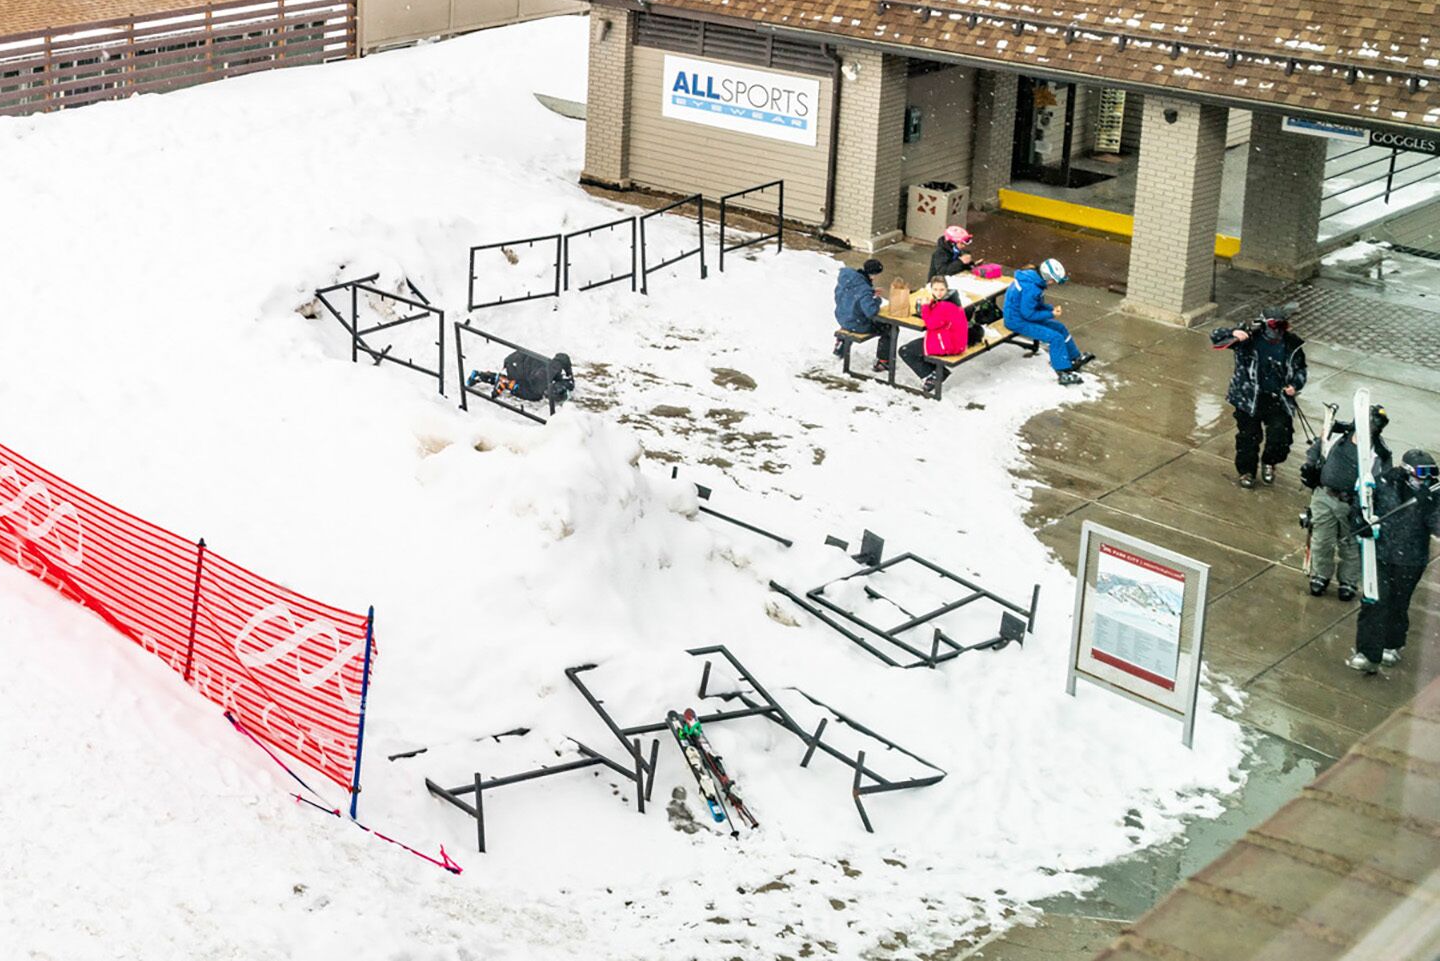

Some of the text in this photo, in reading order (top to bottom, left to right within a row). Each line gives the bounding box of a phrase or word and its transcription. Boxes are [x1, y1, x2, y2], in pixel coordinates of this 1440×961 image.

[672, 70, 809, 117] ALLSPORTS
[676, 97, 803, 127] EYEWEAR
[1371, 131, 1436, 152] GOGGLES
